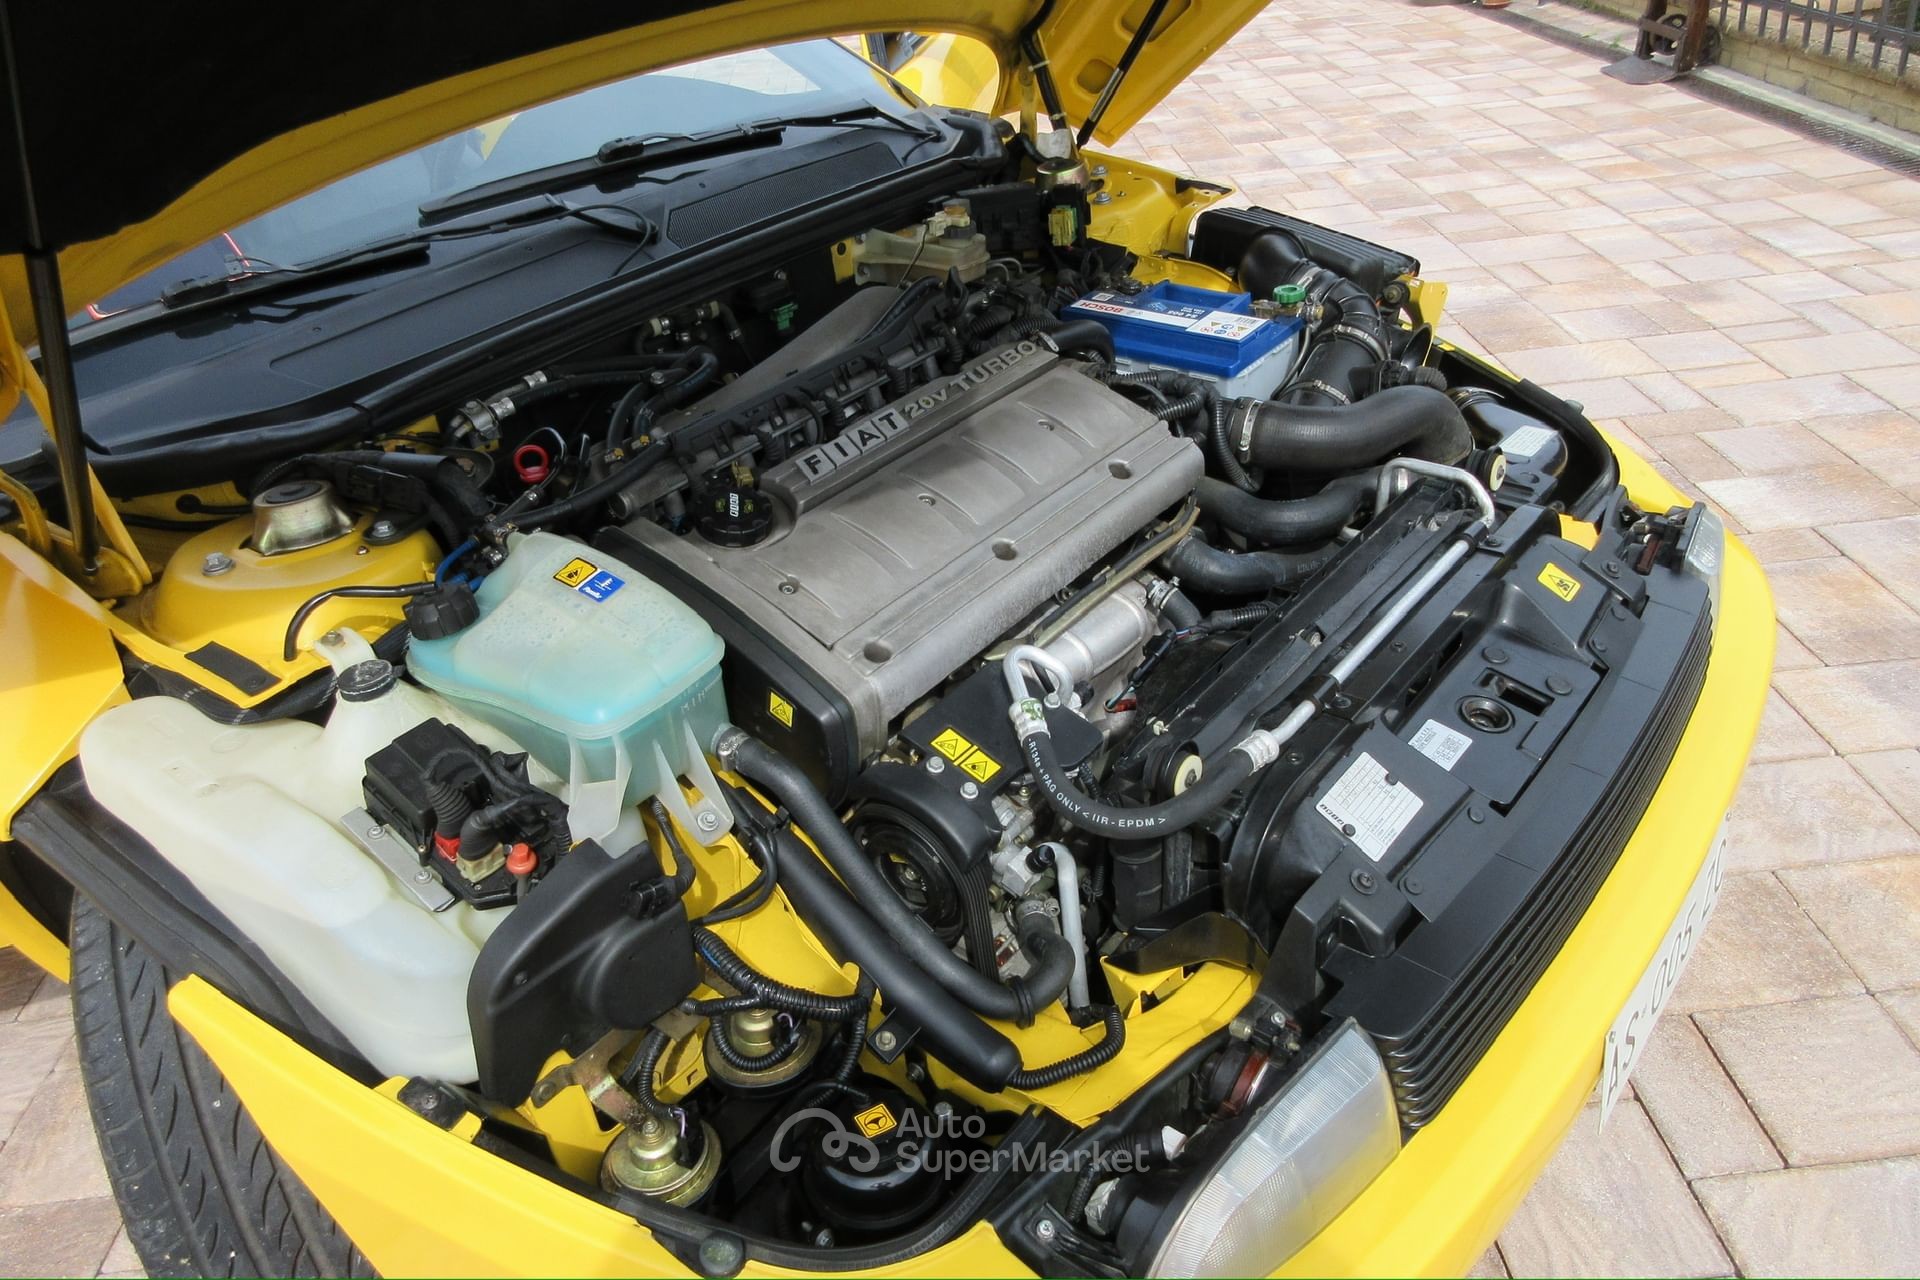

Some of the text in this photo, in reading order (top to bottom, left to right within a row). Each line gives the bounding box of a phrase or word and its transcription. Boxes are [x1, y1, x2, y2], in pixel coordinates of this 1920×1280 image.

[1080, 302, 1123, 313] BOSCH
[803, 412, 901, 475] FIAT
[950, 340, 1037, 392] TURBO
[1042, 774, 1057, 792] PAG
[1056, 792, 1081, 813] ONLY
[1607, 1010, 1640, 1108] AS
[1652, 902, 1697, 1016] 005
